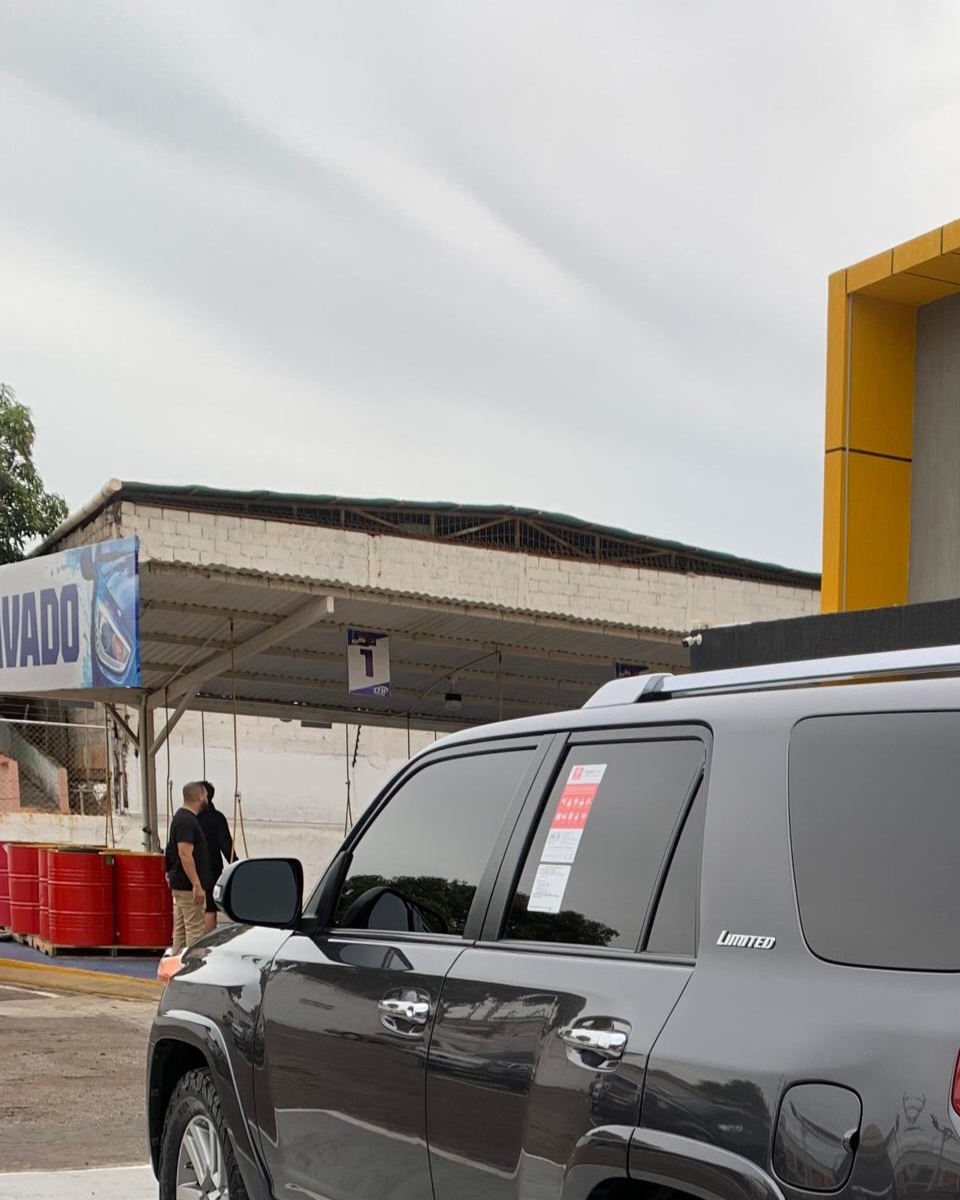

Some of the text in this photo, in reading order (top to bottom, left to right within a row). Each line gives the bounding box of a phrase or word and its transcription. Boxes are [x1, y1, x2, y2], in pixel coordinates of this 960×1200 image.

[0, 583, 80, 668] VADO
[360, 648, 374, 678] 1
[716, 930, 776, 950] LIMITED
